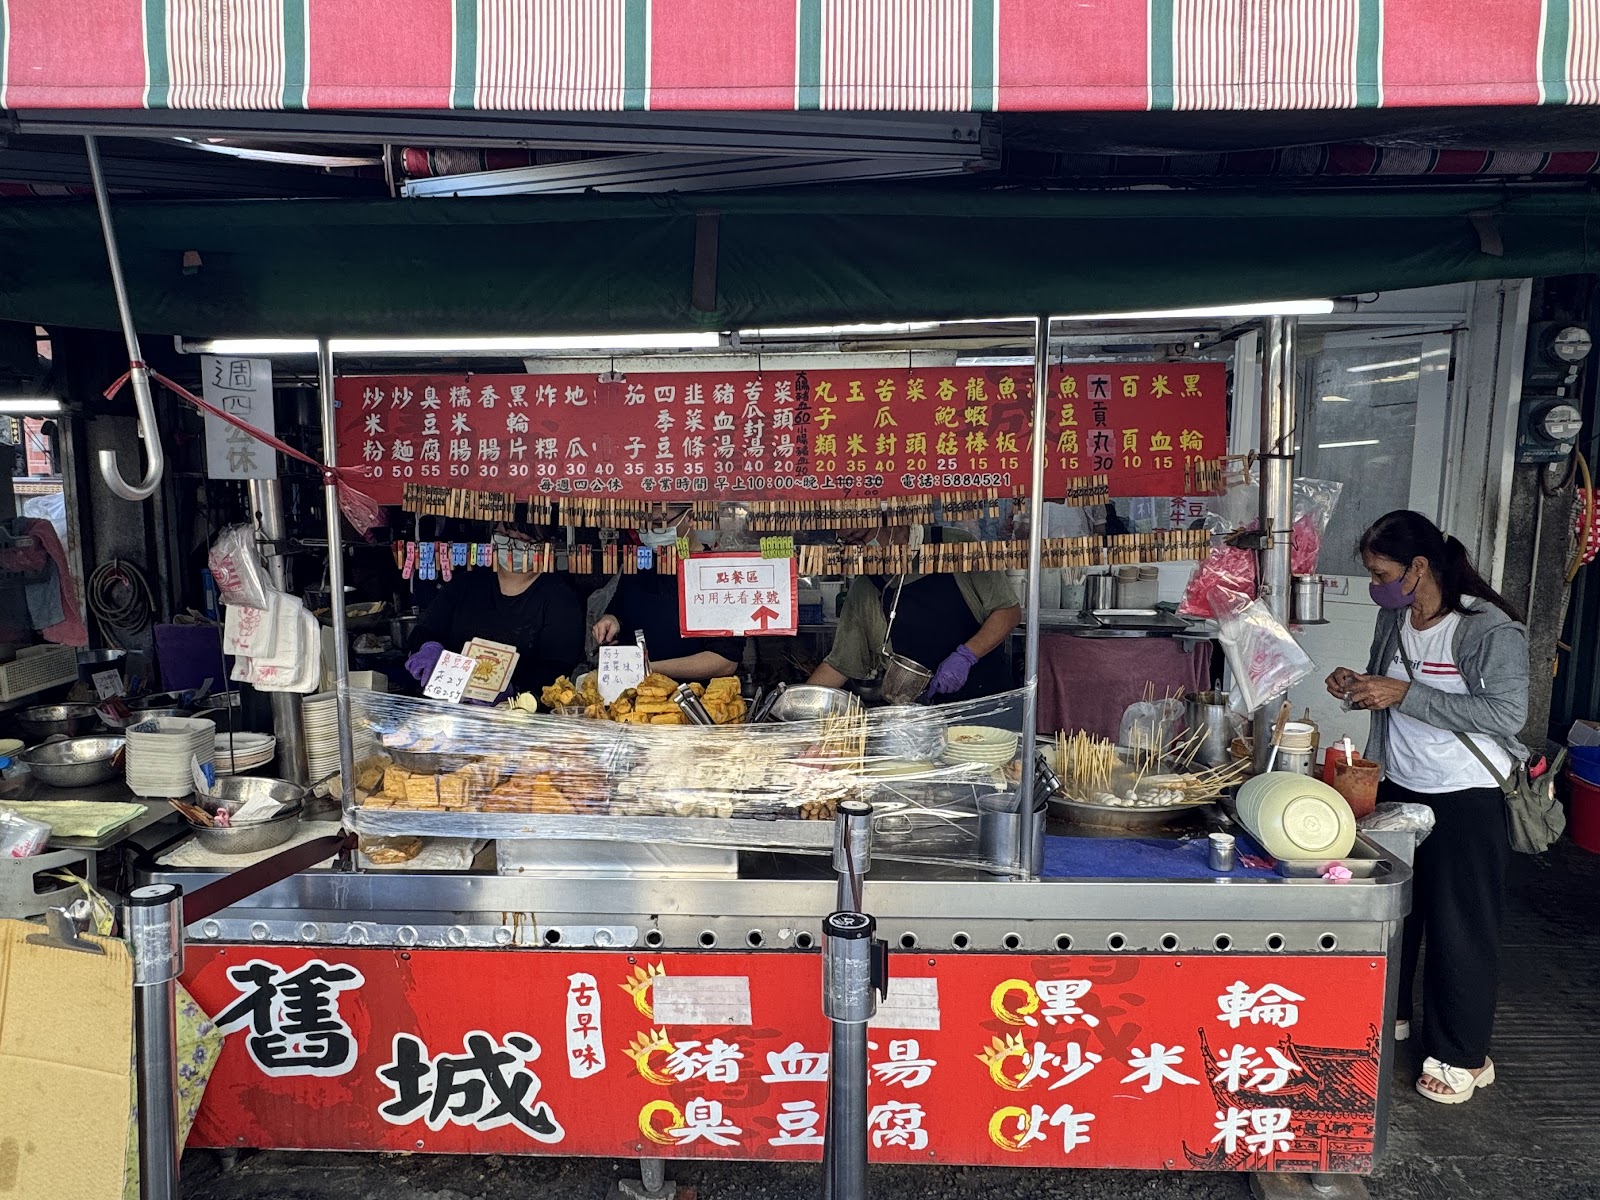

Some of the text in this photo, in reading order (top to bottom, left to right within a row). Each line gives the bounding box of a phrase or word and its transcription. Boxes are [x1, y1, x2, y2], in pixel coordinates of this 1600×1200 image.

[212, 359, 258, 473] 週四公休
[362, 386, 385, 478] 炒米粉 50
[390, 386, 414, 478] 炒麵 50
[420, 385, 441, 476] 臭豆腐 55
[449, 385, 472, 476] 糯米腸 50
[477, 384, 501, 477] 香腸 30
[506, 385, 530, 476] 黑輪片 30
[534, 384, 559, 476] 炸粿 30
[564, 385, 589, 475] 地瓜 30
[624, 384, 647, 475] 茄子 35
[654, 385, 676, 475] 四季豆 35
[682, 383, 706, 474] 韭菜條 35
[712, 383, 736, 474] 豬血湯 30
[741, 381, 766, 473] 苦瓜封湯 40
[772, 381, 795, 472] 菜頭湯 20
[814, 381, 838, 472] 丸子類 20
[846, 381, 868, 472] 玉米 35
[873, 378, 898, 472] 苦瓜封 40
[905, 378, 928, 471] 菜頭 20
[934, 378, 960, 470] 杏鮑菇 25
[964, 376, 990, 470] 龍蝦棒 15
[996, 376, 1020, 470] 魚板 15
[1056, 376, 1079, 470] 魚豆腐 15
[1091, 377, 1113, 472] 大貢丸 30
[1120, 374, 1142, 468] 百頁 10
[1150, 374, 1173, 469] 米血 15
[1180, 374, 1204, 452] 黑輪
[538, 477, 623, 492] 每週四公休
[641, 476, 709, 492] 營業時間
[901, 473, 1011, 490] 電話:5884521
[594, 463, 614, 476] 40
[694, 590, 780, 604] 內用先看桌號
[716, 570, 759, 584] 點餐區
[571, 981, 601, 1071] 古早味
[1017, 1041, 1302, 1093] 炒米粉
[669, 1096, 929, 1150] 臭豆腐
